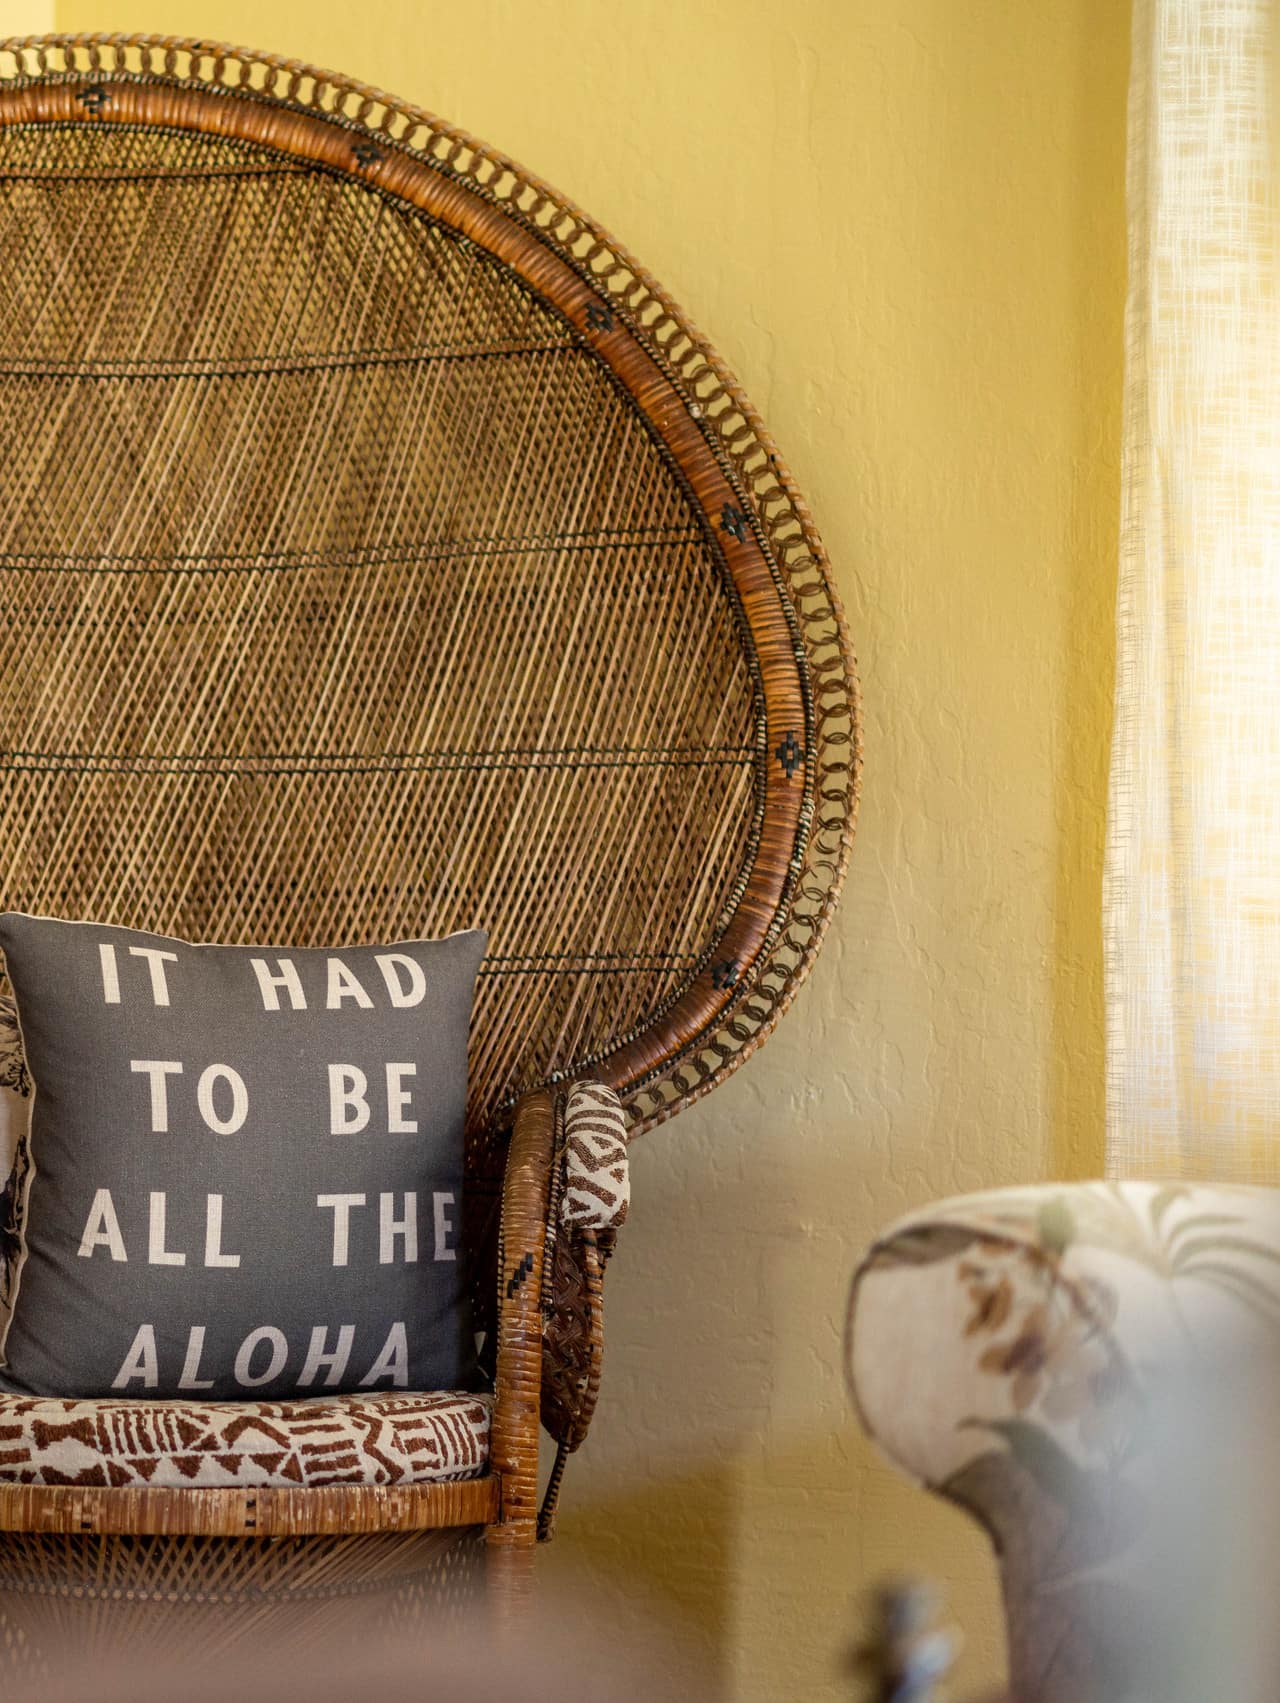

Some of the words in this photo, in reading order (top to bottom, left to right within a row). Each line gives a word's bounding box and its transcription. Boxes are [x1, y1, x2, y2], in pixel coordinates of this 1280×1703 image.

[99, 943, 178, 1006] IT
[250, 953, 427, 1010] HAD
[130, 1060, 249, 1135] TO
[327, 1062, 418, 1135] BE
[77, 1188, 241, 1268] ALL
[317, 1191, 457, 1266] THE
[111, 1322, 410, 1389] ALOHA
